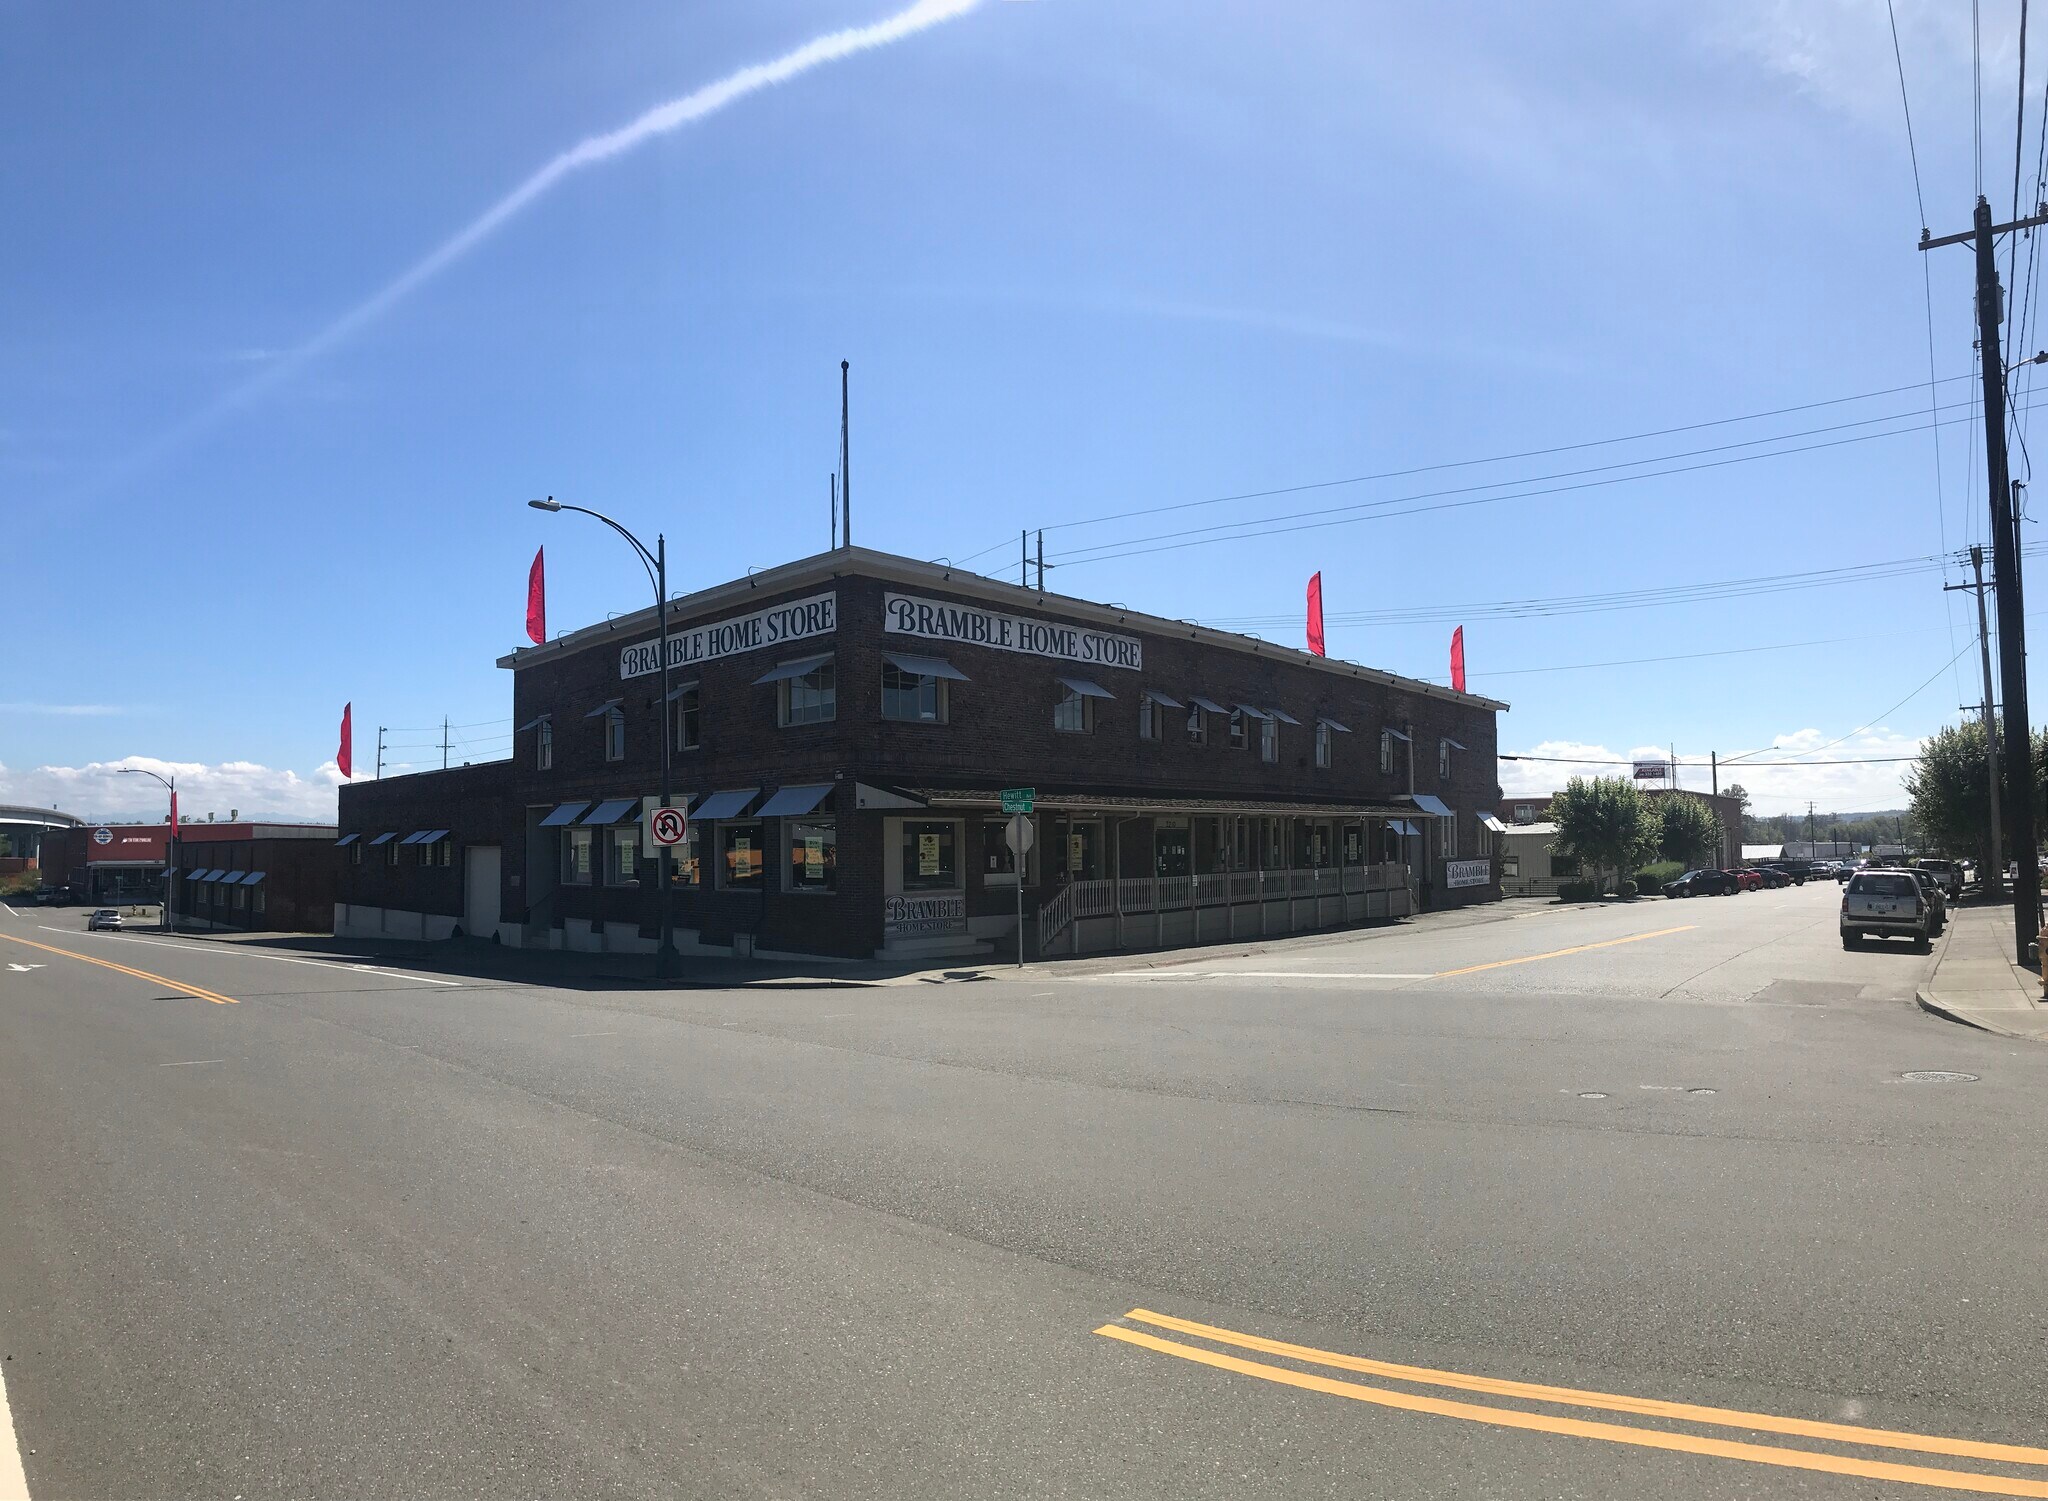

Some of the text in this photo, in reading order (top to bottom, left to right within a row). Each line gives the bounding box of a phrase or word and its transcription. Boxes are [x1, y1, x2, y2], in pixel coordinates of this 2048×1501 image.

[708, 617, 762, 656] HOME
[766, 598, 834, 643] STORE
[887, 597, 1140, 668] BRAMBLE HOME STORE
[1002, 790, 1022, 800] Hewitt
[1004, 802, 1026, 811] Chestnut
[1448, 864, 1489, 879] BRAMBLE
[886, 896, 963, 921] BRAMBLE
[896, 920, 953, 933] HOME STORE
